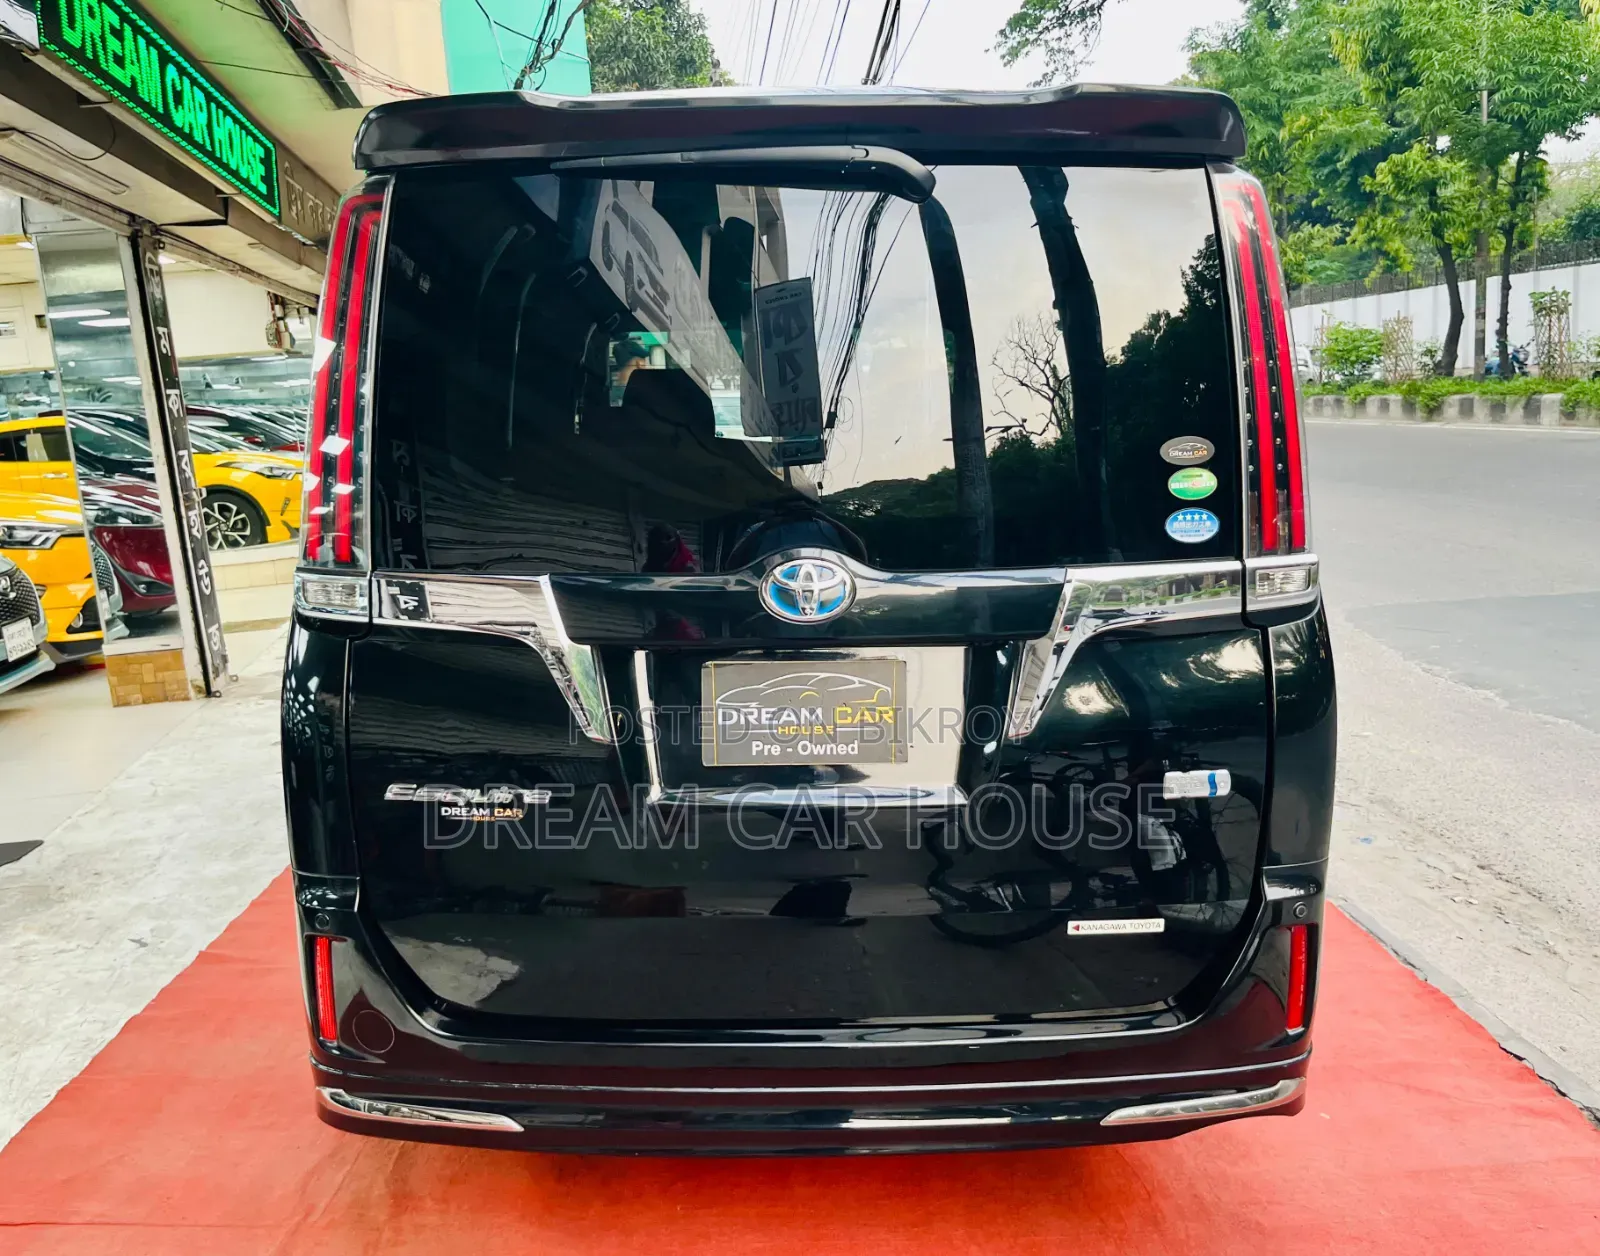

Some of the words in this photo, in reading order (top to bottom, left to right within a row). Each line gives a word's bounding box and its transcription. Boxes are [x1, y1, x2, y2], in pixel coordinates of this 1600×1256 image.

[60, 0, 164, 114] DREAM
[165, 63, 212, 151] CAR
[210, 102, 268, 195] HOUSE
[717, 707, 823, 725] DREAM
[834, 706, 895, 724] CAR
[777, 725, 834, 735] HOUSE
[752, 741, 781, 756] Pre
[797, 740, 859, 756] Owned
[441, 806, 491, 816] DREAM
[494, 808, 523, 818] CAR
[1080, 923, 1127, 931] KANAGAWA
[1129, 922, 1161, 930] TOYOTA
